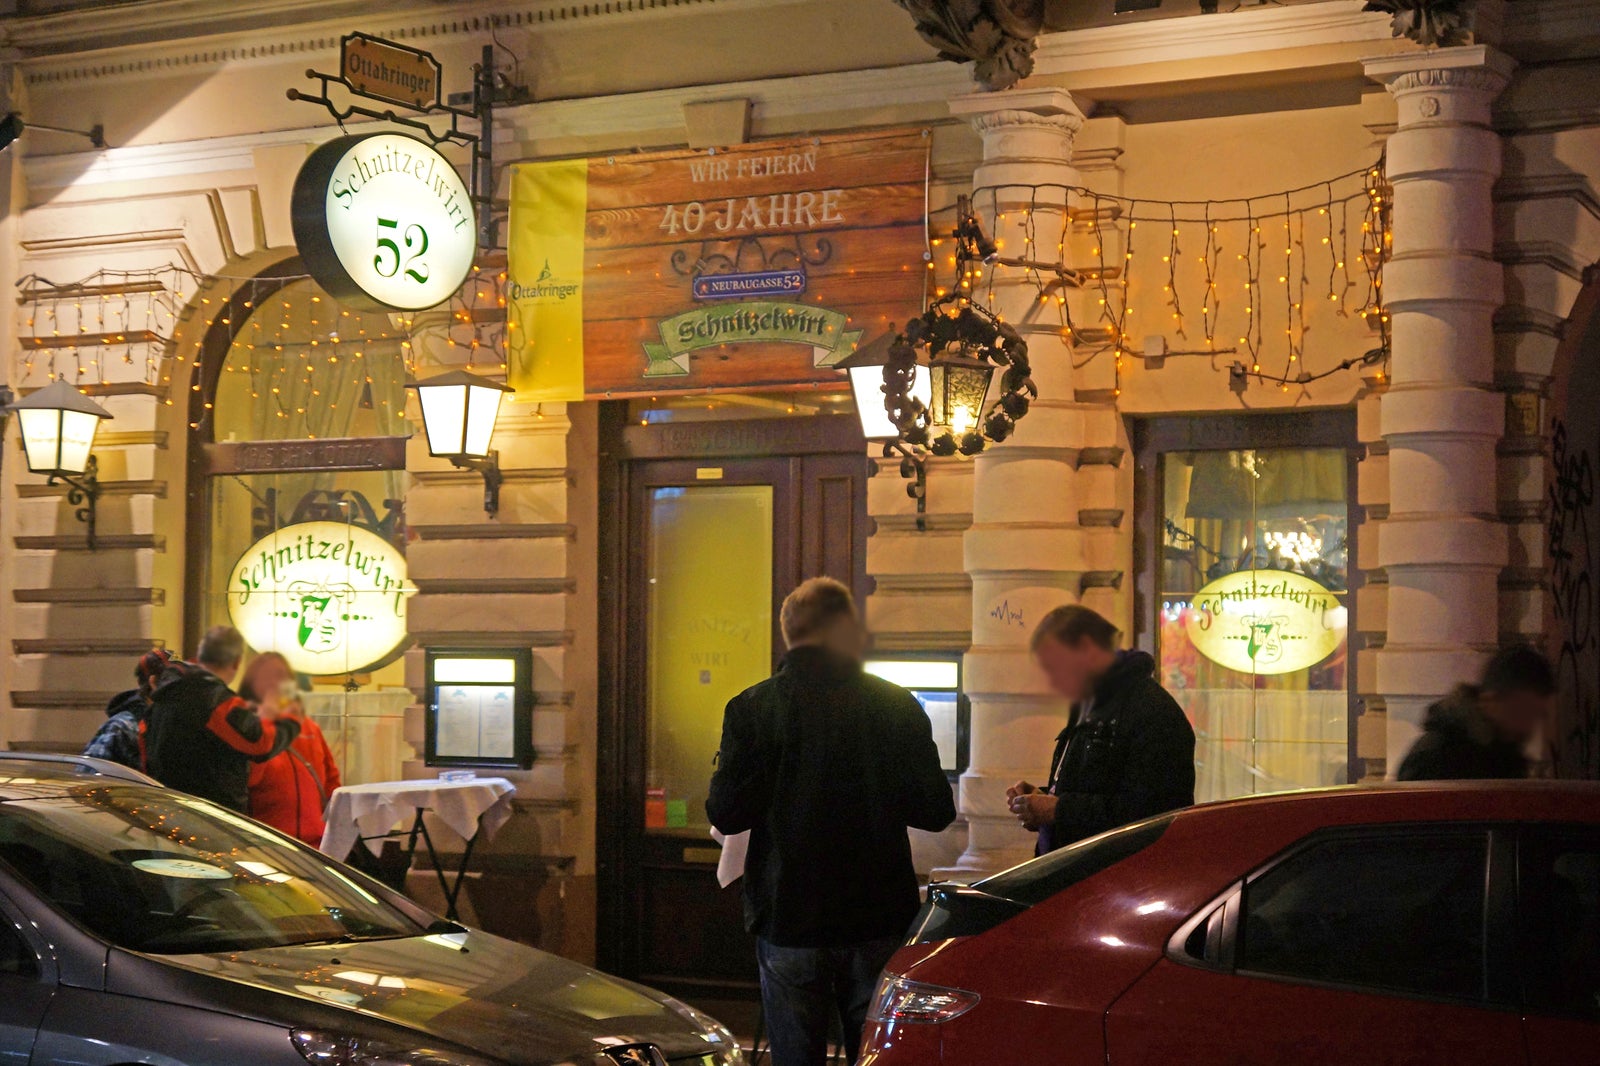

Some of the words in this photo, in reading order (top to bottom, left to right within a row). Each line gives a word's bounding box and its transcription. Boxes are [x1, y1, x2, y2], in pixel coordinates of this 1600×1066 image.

[350, 53, 431, 93] Ottakringer
[332, 144, 471, 234] Schnitzelwirt
[690, 159, 730, 183] WIR
[737, 152, 817, 179] FEIERN
[659, 202, 706, 235] 40
[715, 189, 846, 232] JAHRE
[373, 215, 430, 284] 52
[512, 283, 578, 301] Ottakringer
[712, 277, 783, 291] NEUBAUGASSE
[783, 274, 800, 289] 52
[677, 308, 827, 342] Schnitzelwirt
[239, 534, 404, 618] Schnitzelwirt
[1199, 580, 1332, 632] Schnitzelwirt
